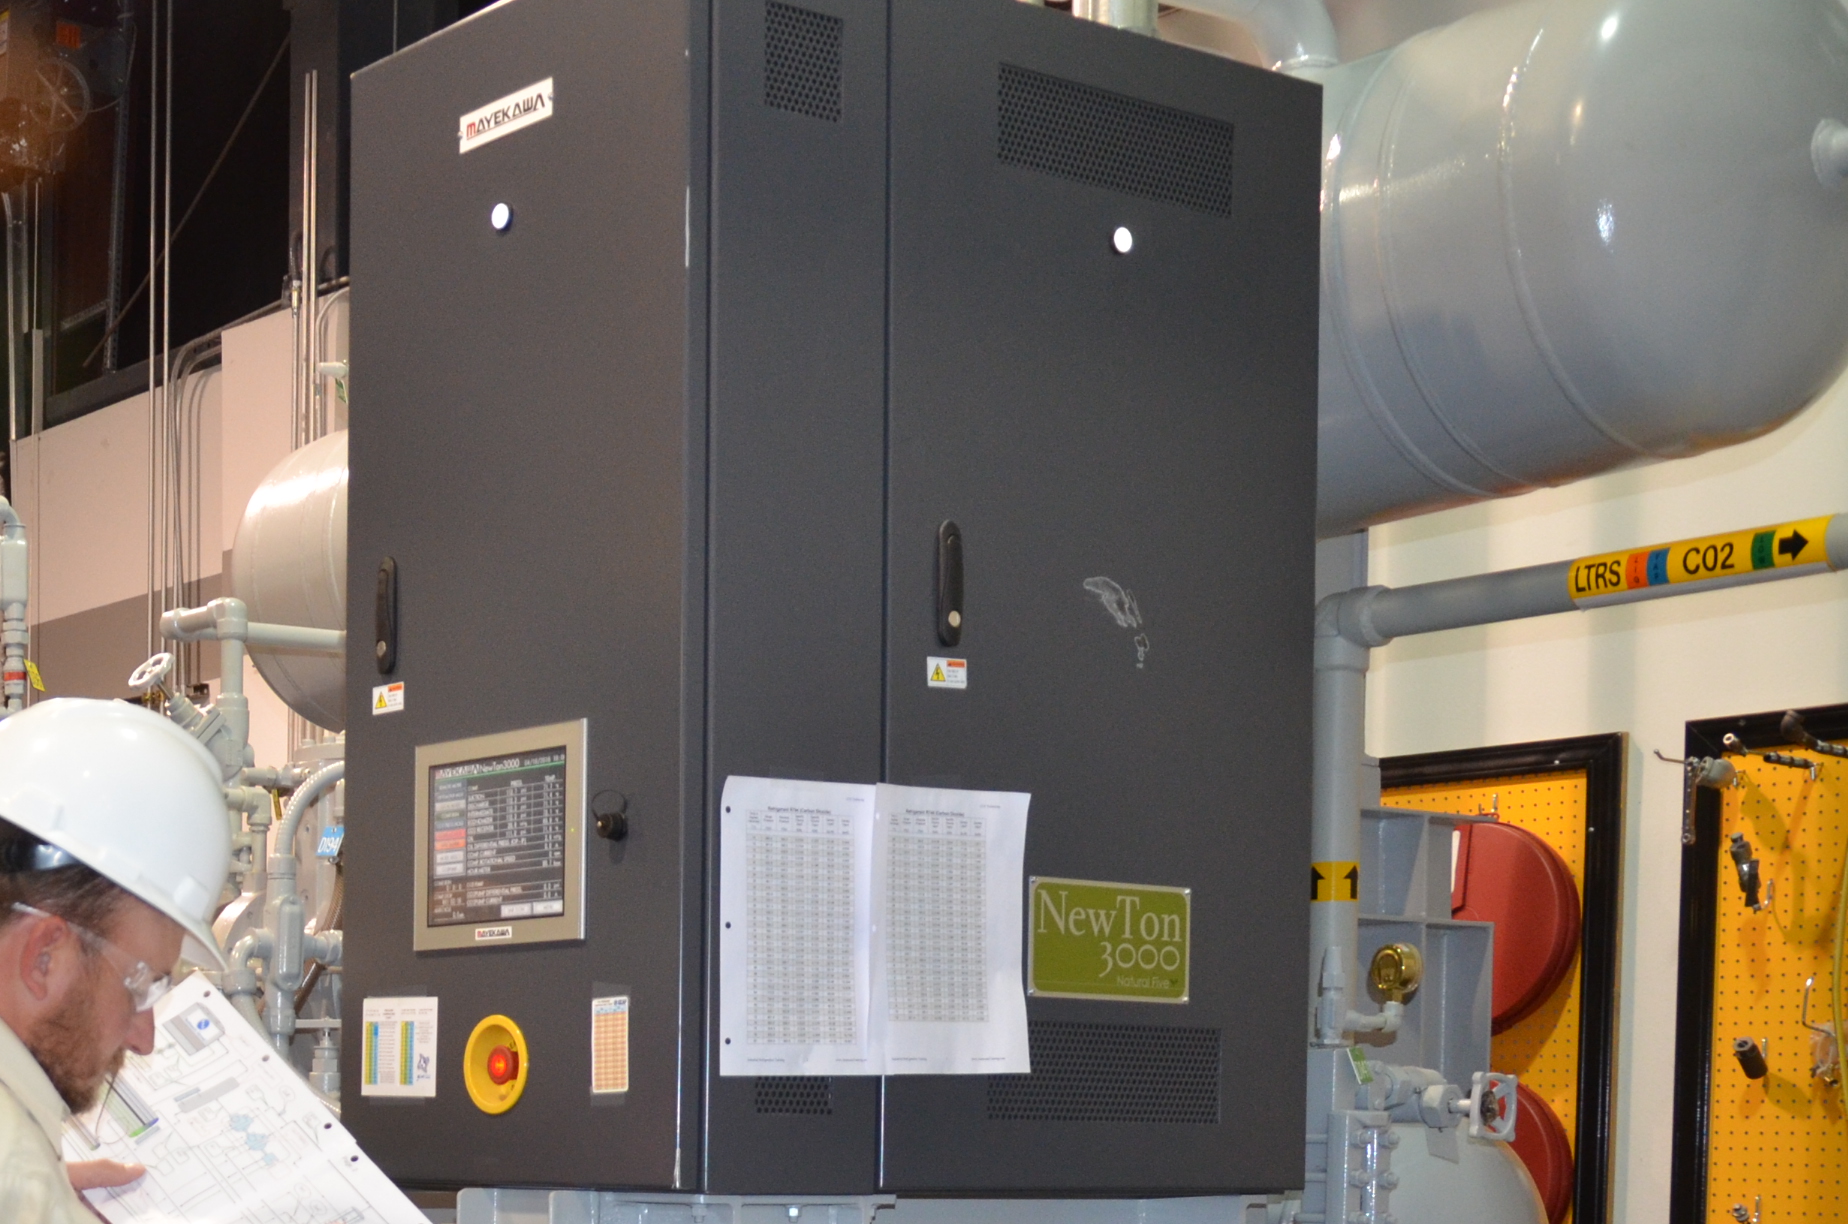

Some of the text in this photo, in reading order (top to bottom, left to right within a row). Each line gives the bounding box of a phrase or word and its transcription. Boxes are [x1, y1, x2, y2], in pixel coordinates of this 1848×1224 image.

[466, 93, 545, 138] MAYEKAWA
[1575, 560, 1621, 593] LTRS
[1682, 542, 1735, 575] CO2
[1037, 889, 1182, 942] NewTon
[1099, 941, 1180, 977] 3000
[1117, 975, 1170, 989] Natural Five
